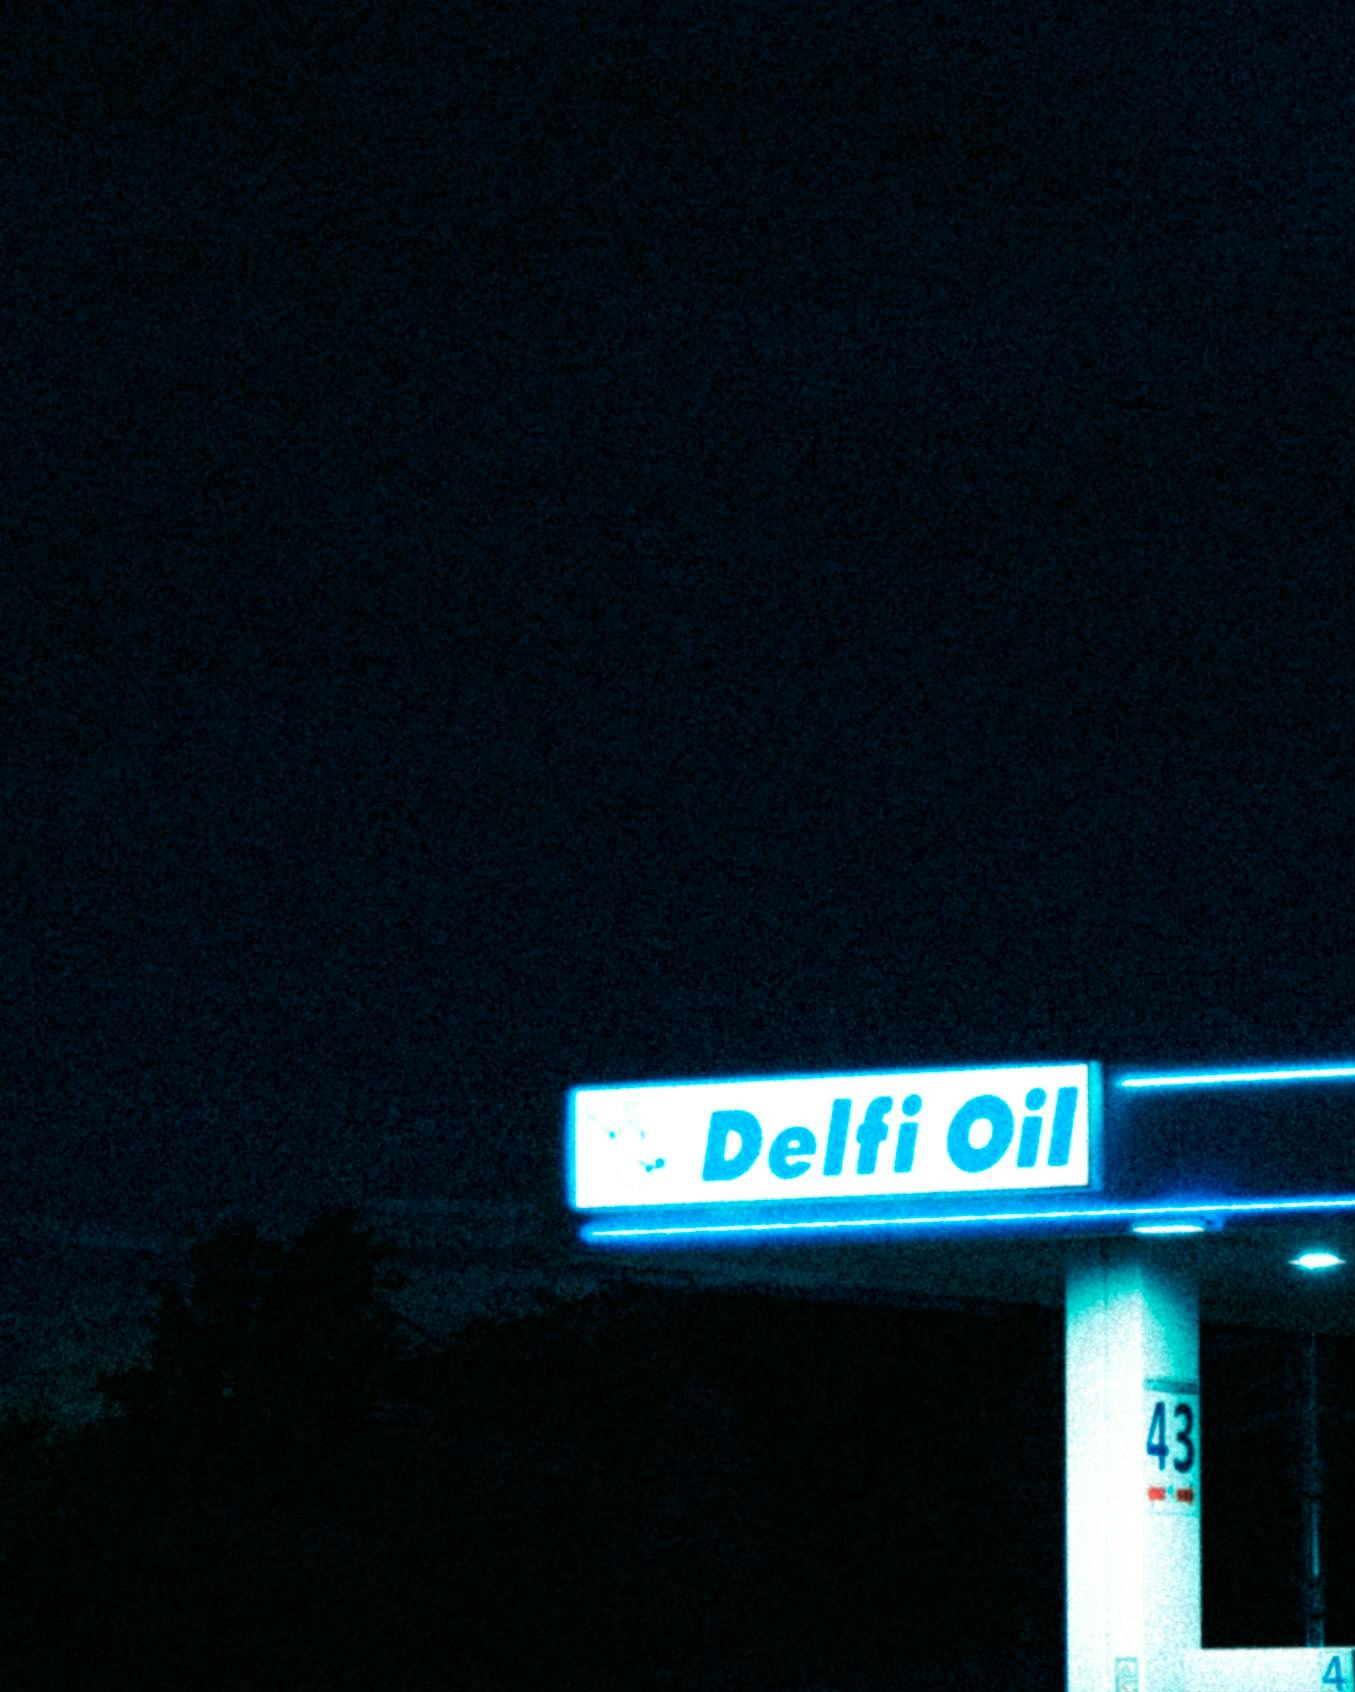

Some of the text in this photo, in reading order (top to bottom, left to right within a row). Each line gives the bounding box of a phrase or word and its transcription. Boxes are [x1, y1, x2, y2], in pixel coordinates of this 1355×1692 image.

[702, 1087, 1079, 1182] Delfi Oil
[1146, 1401, 1195, 1473] 43
[1322, 1655, 1345, 1692] 4
